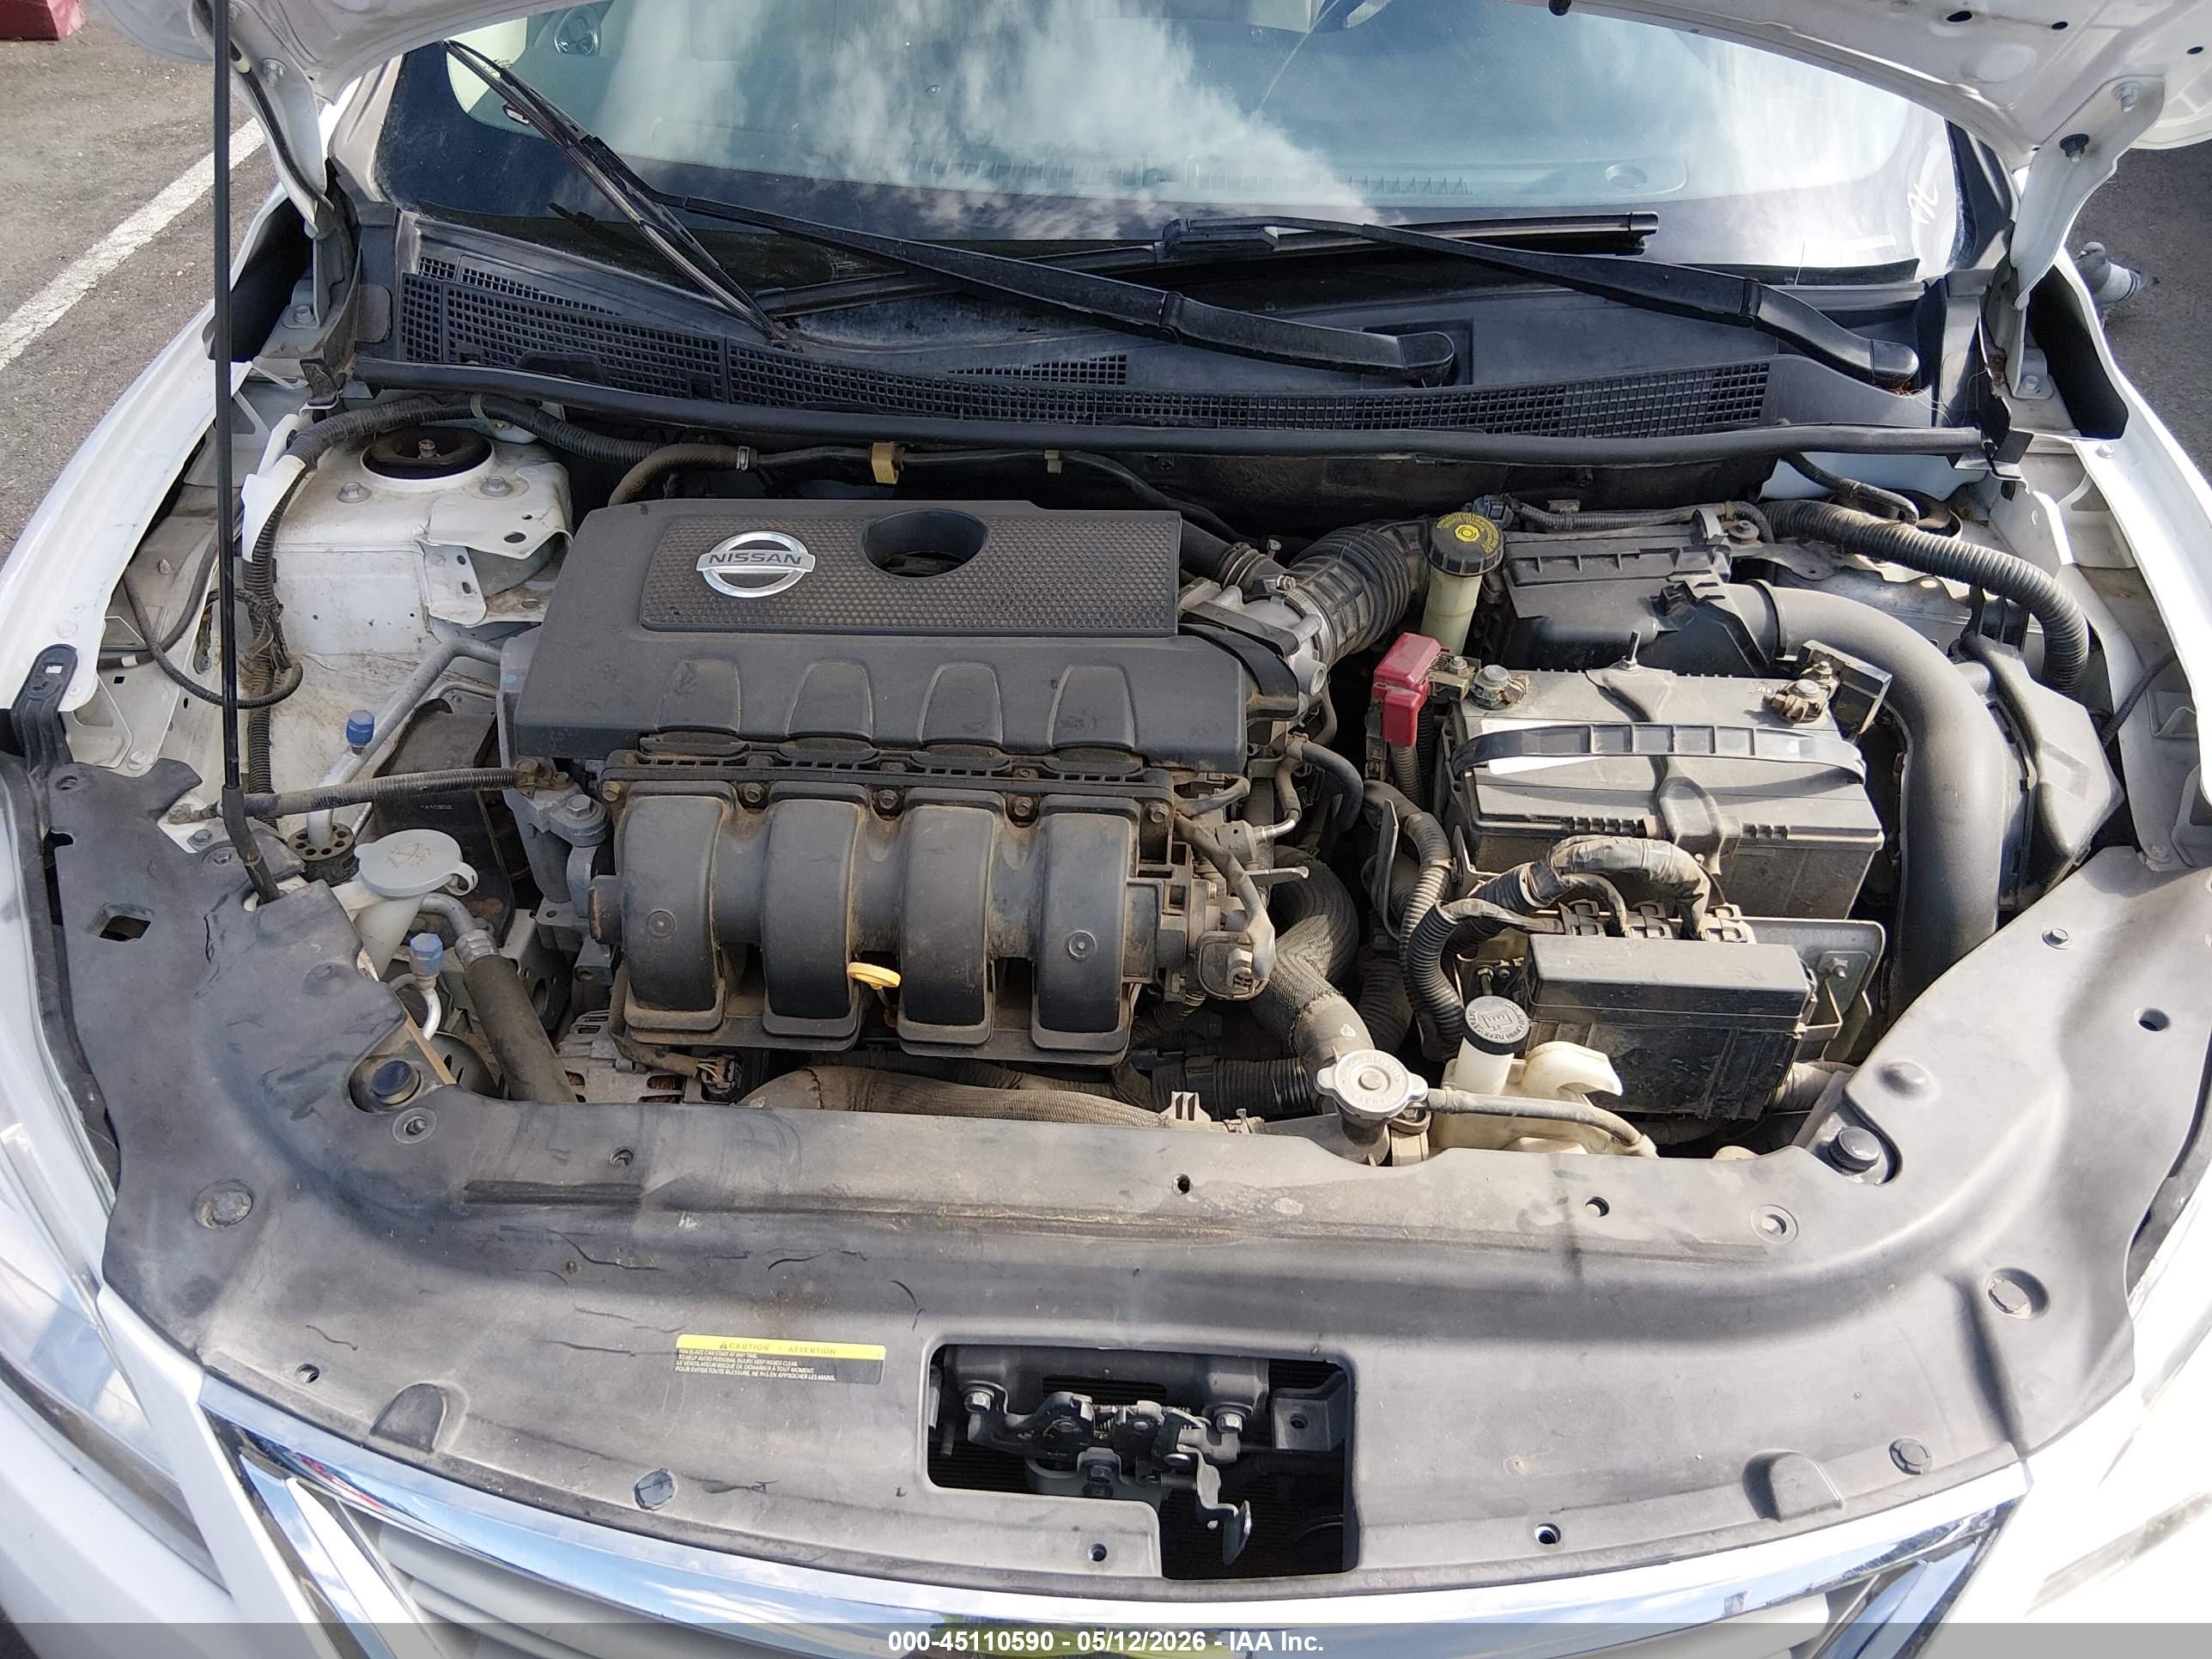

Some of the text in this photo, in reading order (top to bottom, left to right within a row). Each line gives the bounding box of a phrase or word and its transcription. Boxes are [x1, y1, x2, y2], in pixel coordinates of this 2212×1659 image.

[709, 553, 801, 564] NISSAN
[728, 1343, 769, 1352] CAUTION
[788, 1346, 836, 1355] ATTENTION
